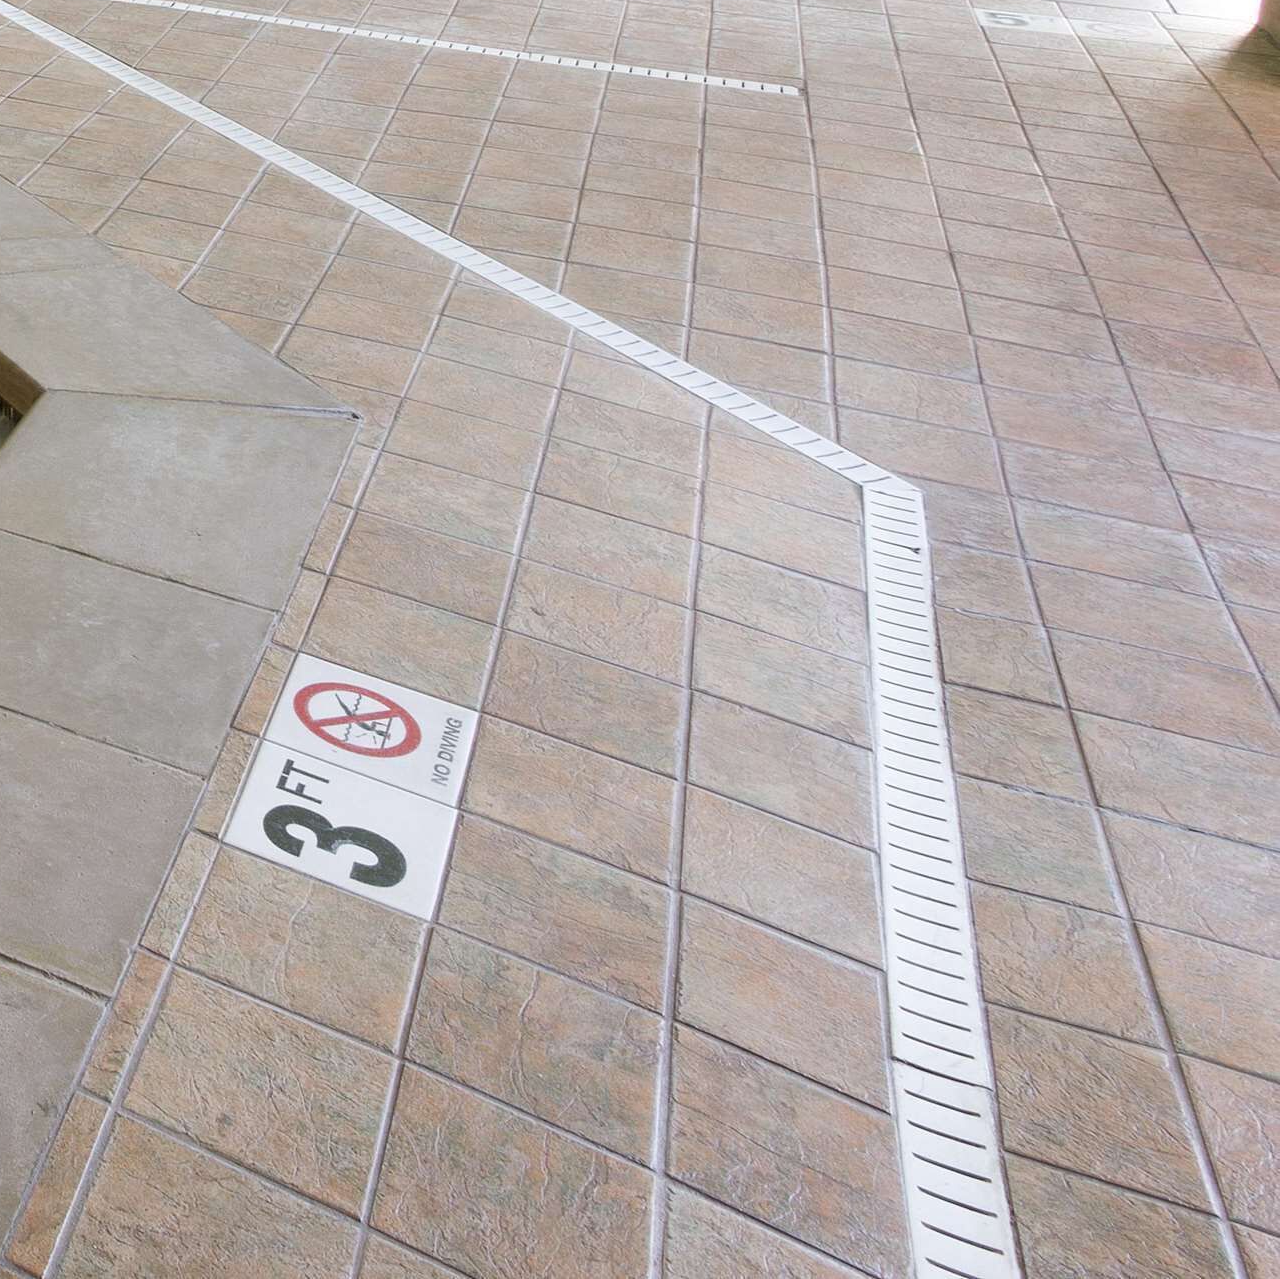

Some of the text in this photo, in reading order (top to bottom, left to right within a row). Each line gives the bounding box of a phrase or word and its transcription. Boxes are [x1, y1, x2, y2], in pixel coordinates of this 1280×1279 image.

[430, 717, 462, 787] NO DIVING
[262, 758, 408, 888] 3 FT
